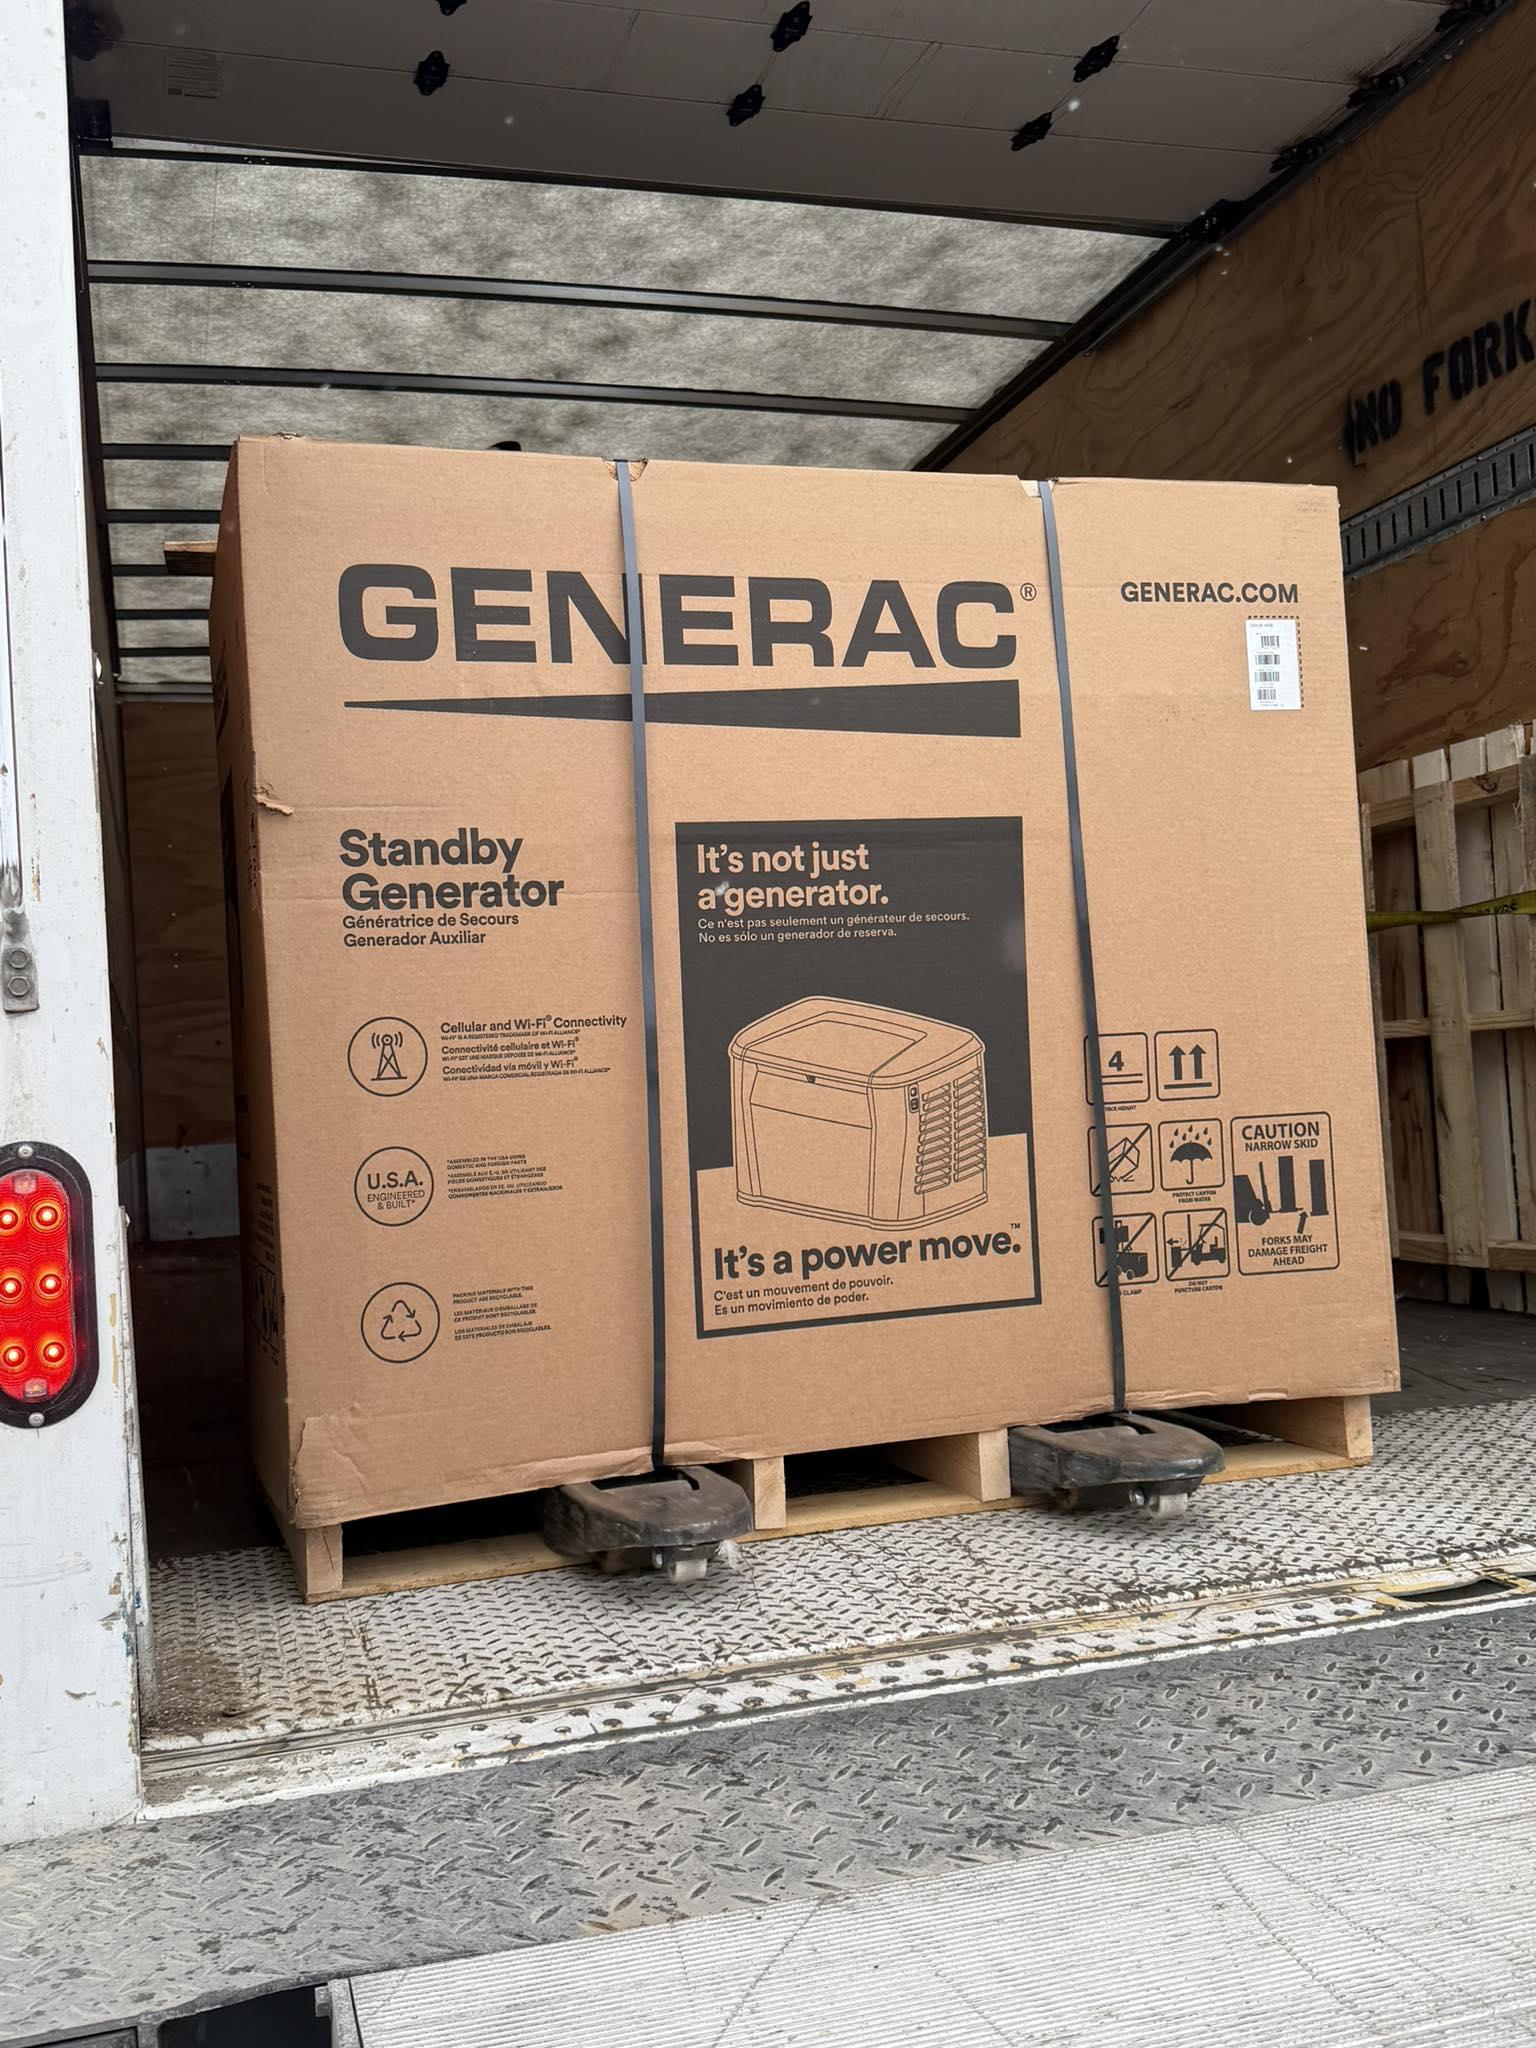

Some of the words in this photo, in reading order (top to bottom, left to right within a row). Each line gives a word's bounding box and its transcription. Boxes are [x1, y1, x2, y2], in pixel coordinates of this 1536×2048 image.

[1349, 378, 1402, 456] NO
[1120, 581, 1299, 603] GENERAC.COM
[340, 827, 523, 874] Standby
[752, 844, 805, 873] not
[810, 841, 870, 879] just
[342, 872, 565, 911] Generator
[698, 888, 716, 910] a
[724, 880, 889, 917] generator.
[342, 912, 434, 929] Génératrice
[438, 912, 456, 927] de
[460, 912, 519, 927] Secours
[698, 918, 715, 929] Ce
[747, 918, 767, 931] pas
[770, 914, 827, 927] seulement
[830, 916, 844, 925] un
[847, 912, 906, 927] générateur
[909, 912, 923, 923] de
[925, 912, 971, 923] secours.
[344, 931, 426, 948] Generador
[430, 930, 487, 946] Auxiliar
[698, 932, 715, 943] No
[718, 933, 732, 943] es
[734, 930, 757, 942] sólo
[760, 931, 774, 941] un
[777, 929, 835, 943] generador
[837, 928, 851, 939] de
[854, 927, 897, 938] reserva.
[440, 1020, 486, 1034] Cellular
[490, 1019, 512, 1031] and
[554, 1014, 627, 1029] Connectivity
[442, 1043, 499, 1054] Connectivité
[500, 1042, 539, 1051] cellulaire
[541, 1041, 549, 1049] et
[442, 1063, 501, 1075] Conectividad
[504, 1062, 516, 1072] vía
[518, 1060, 541, 1070] móvil
[544, 1062, 549, 1070] y
[1108, 1050, 1125, 1072] 4
[1242, 1121, 1320, 1141] CAUTION
[1245, 1140, 1292, 1152] NARROW
[1294, 1139, 1318, 1149] SKID
[368, 1170, 423, 1190] U.S.A.
[368, 1190, 425, 1202] ENGINEERED
[377, 1202, 384, 1211] &
[1262, 1236, 1292, 1246] FORKS
[1293, 1234, 1313, 1244] MAY
[773, 1250, 793, 1275] a
[802, 1240, 912, 1280] power
[1248, 1247, 1288, 1257] DAMAGE
[1290, 1244, 1328, 1254] FREIGHT
[1273, 1256, 1305, 1266] AHEAD
[746, 1289, 760, 1298] un
[764, 1281, 830, 1297] mouvement
[832, 1279, 847, 1290] de
[849, 1275, 894, 1291] pouvoir.
[714, 1304, 728, 1316] Es
[731, 1304, 745, 1313] un
[748, 1296, 814, 1312] movimiento
[817, 1295, 831, 1305] de
[834, 1292, 869, 1306] poder.
